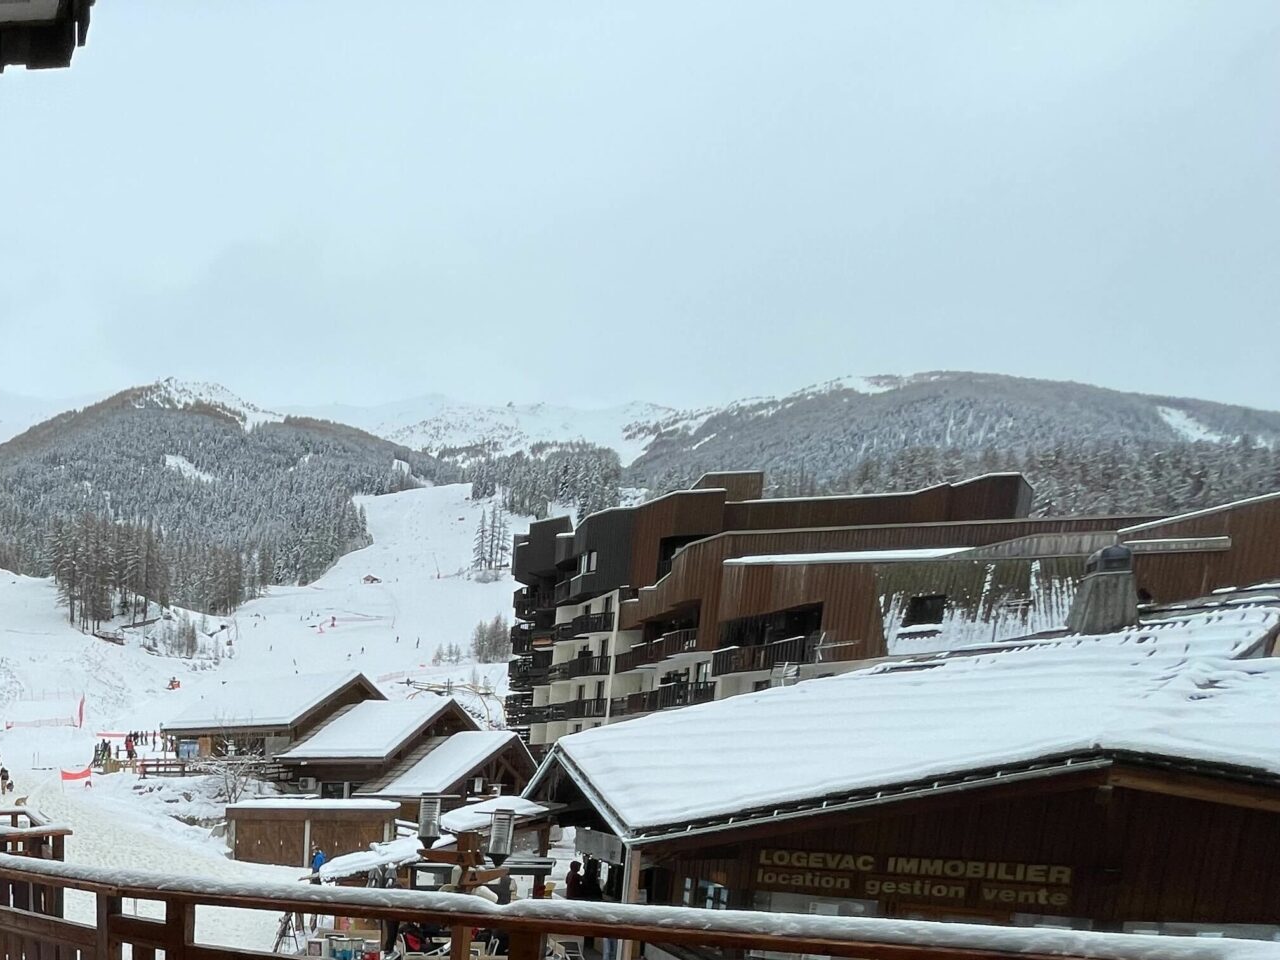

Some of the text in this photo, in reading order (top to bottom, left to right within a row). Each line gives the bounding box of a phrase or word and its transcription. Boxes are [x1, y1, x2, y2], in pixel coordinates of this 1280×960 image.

[759, 849, 1071, 884] LOGEVAC IMMOBILIER
[756, 868, 1069, 905] location gestion vente
